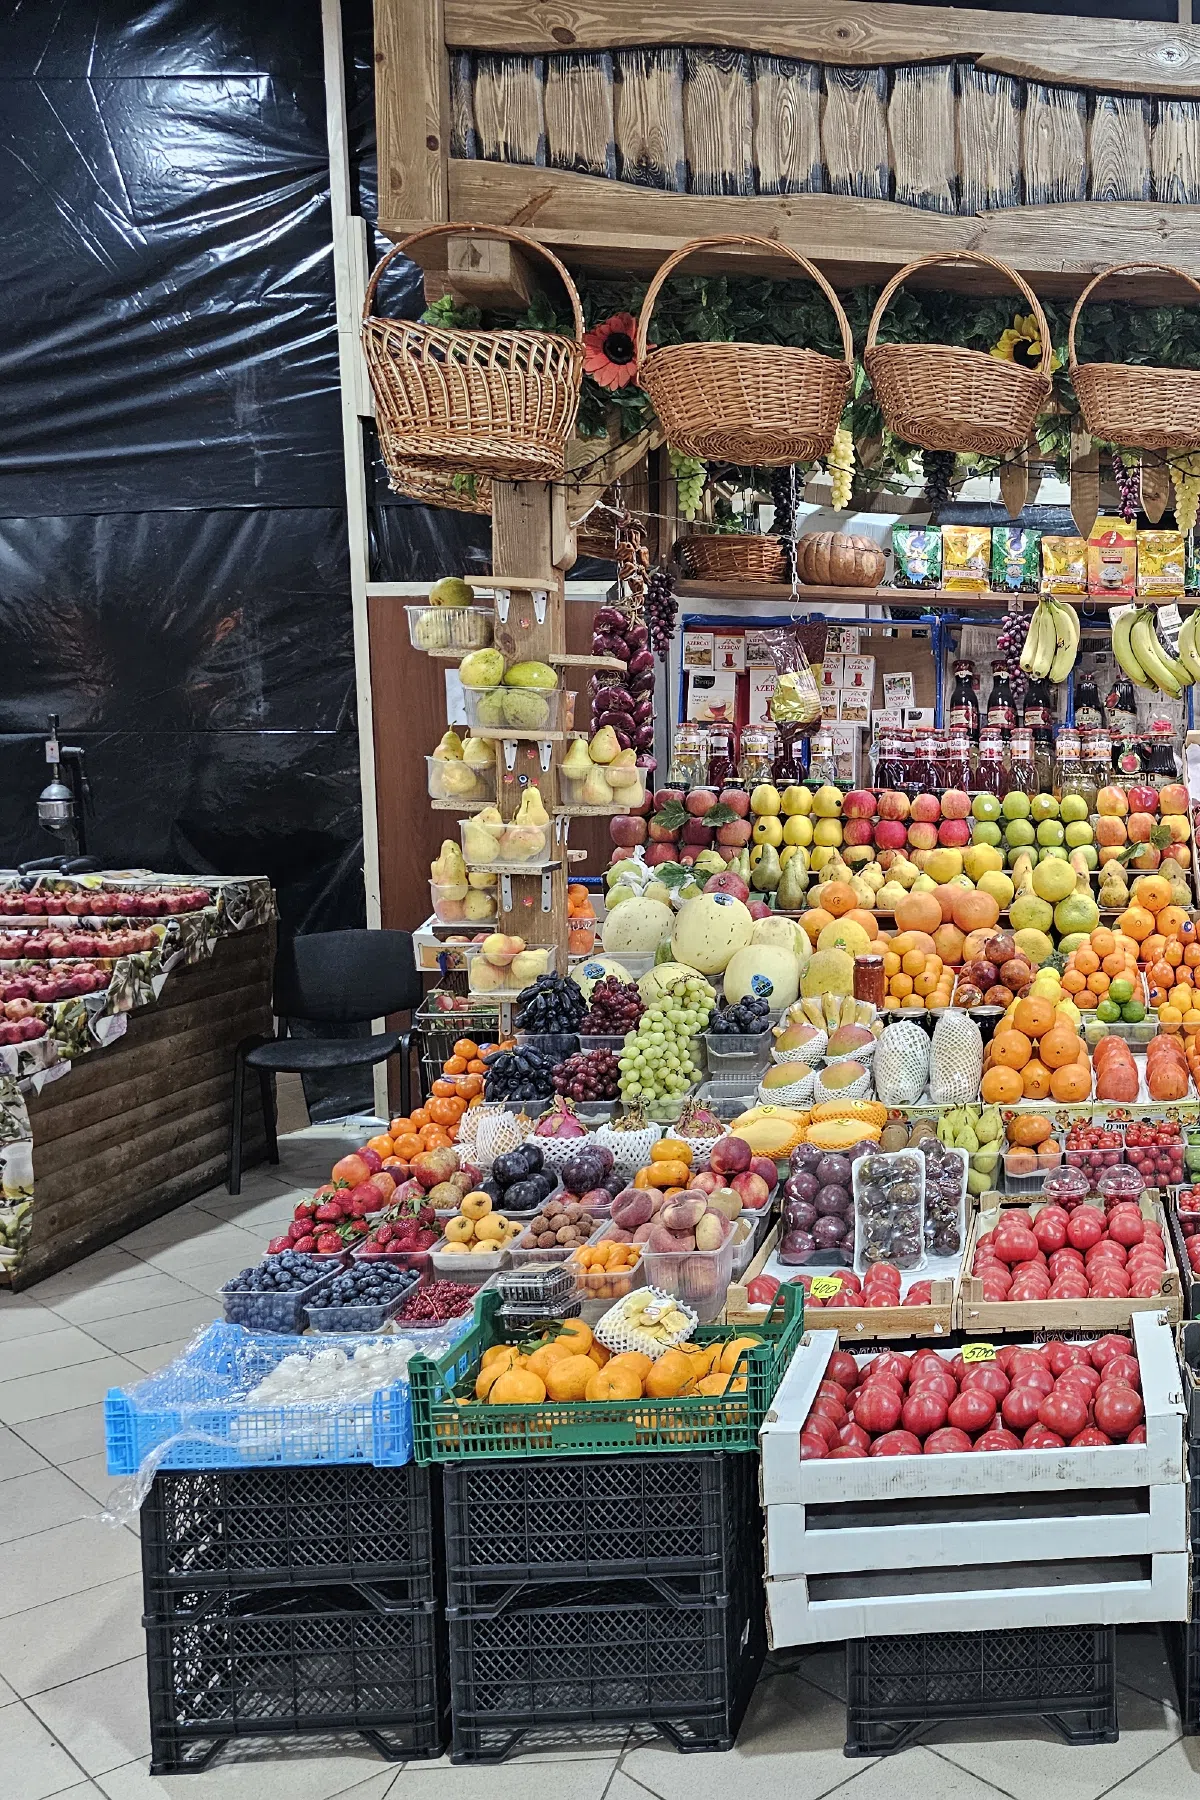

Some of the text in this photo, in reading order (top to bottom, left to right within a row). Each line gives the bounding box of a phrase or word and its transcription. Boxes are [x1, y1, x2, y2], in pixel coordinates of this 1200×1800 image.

[754, 684, 775, 692] AZER
[755, 981, 771, 993] Dino
[813, 1281, 838, 1295] 400
[1161, 1277, 1173, 1293] 6
[965, 1346, 994, 1359] 500
